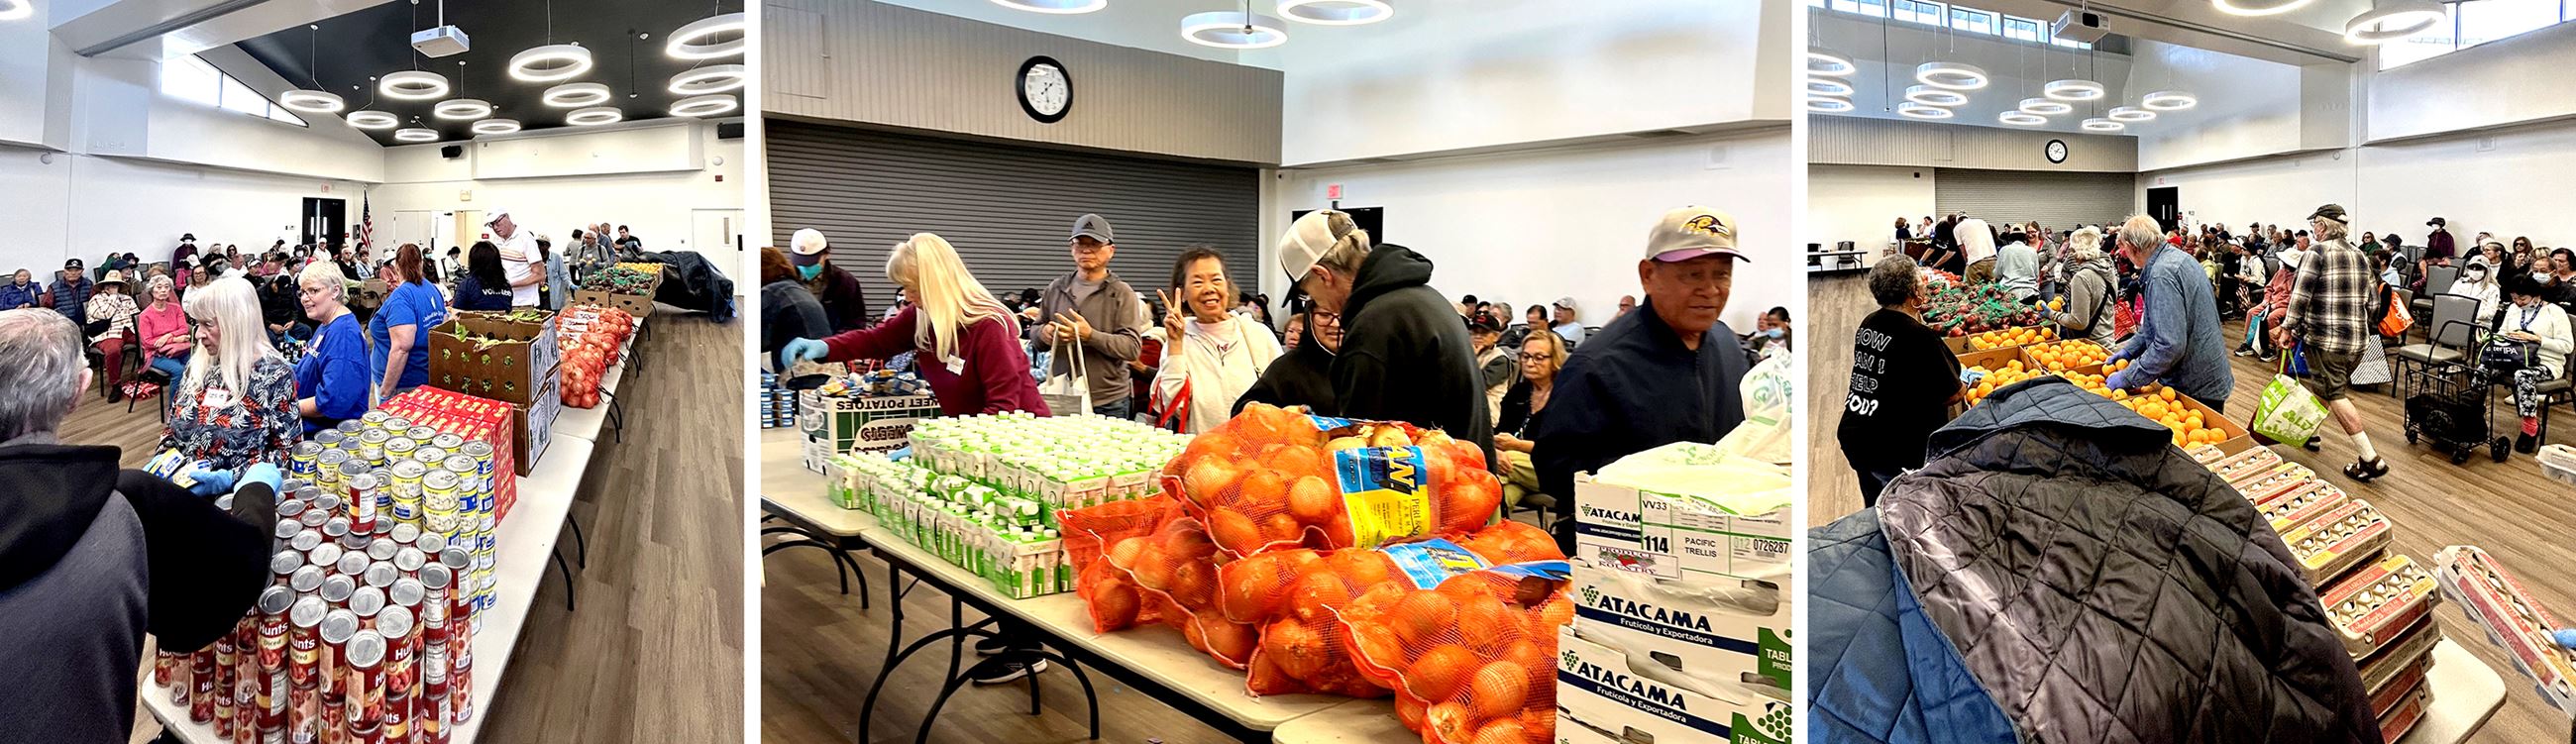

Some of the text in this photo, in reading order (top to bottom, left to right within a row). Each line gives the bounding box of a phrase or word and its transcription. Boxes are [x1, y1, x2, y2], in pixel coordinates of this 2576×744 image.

[1855, 351, 1885, 374] AN I
[836, 397, 939, 410] WEET POTATOES
[1411, 498, 1421, 519] PERI
[1642, 499, 1667, 511] VV33
[1644, 535, 1669, 554] 114
[1684, 536, 1716, 548] PACIFIC
[1753, 538, 1788, 555] 0726287
[1684, 547, 1717, 558] TRELLIS
[1598, 594, 1713, 633] ATACAMA
[1663, 627, 1713, 645] Exportadora
[1765, 648, 1791, 663] TABL
[1771, 662, 1791, 672] PROD
[1576, 661, 1687, 711] ATACAMA
[1637, 700, 1687, 723] Exportadora
